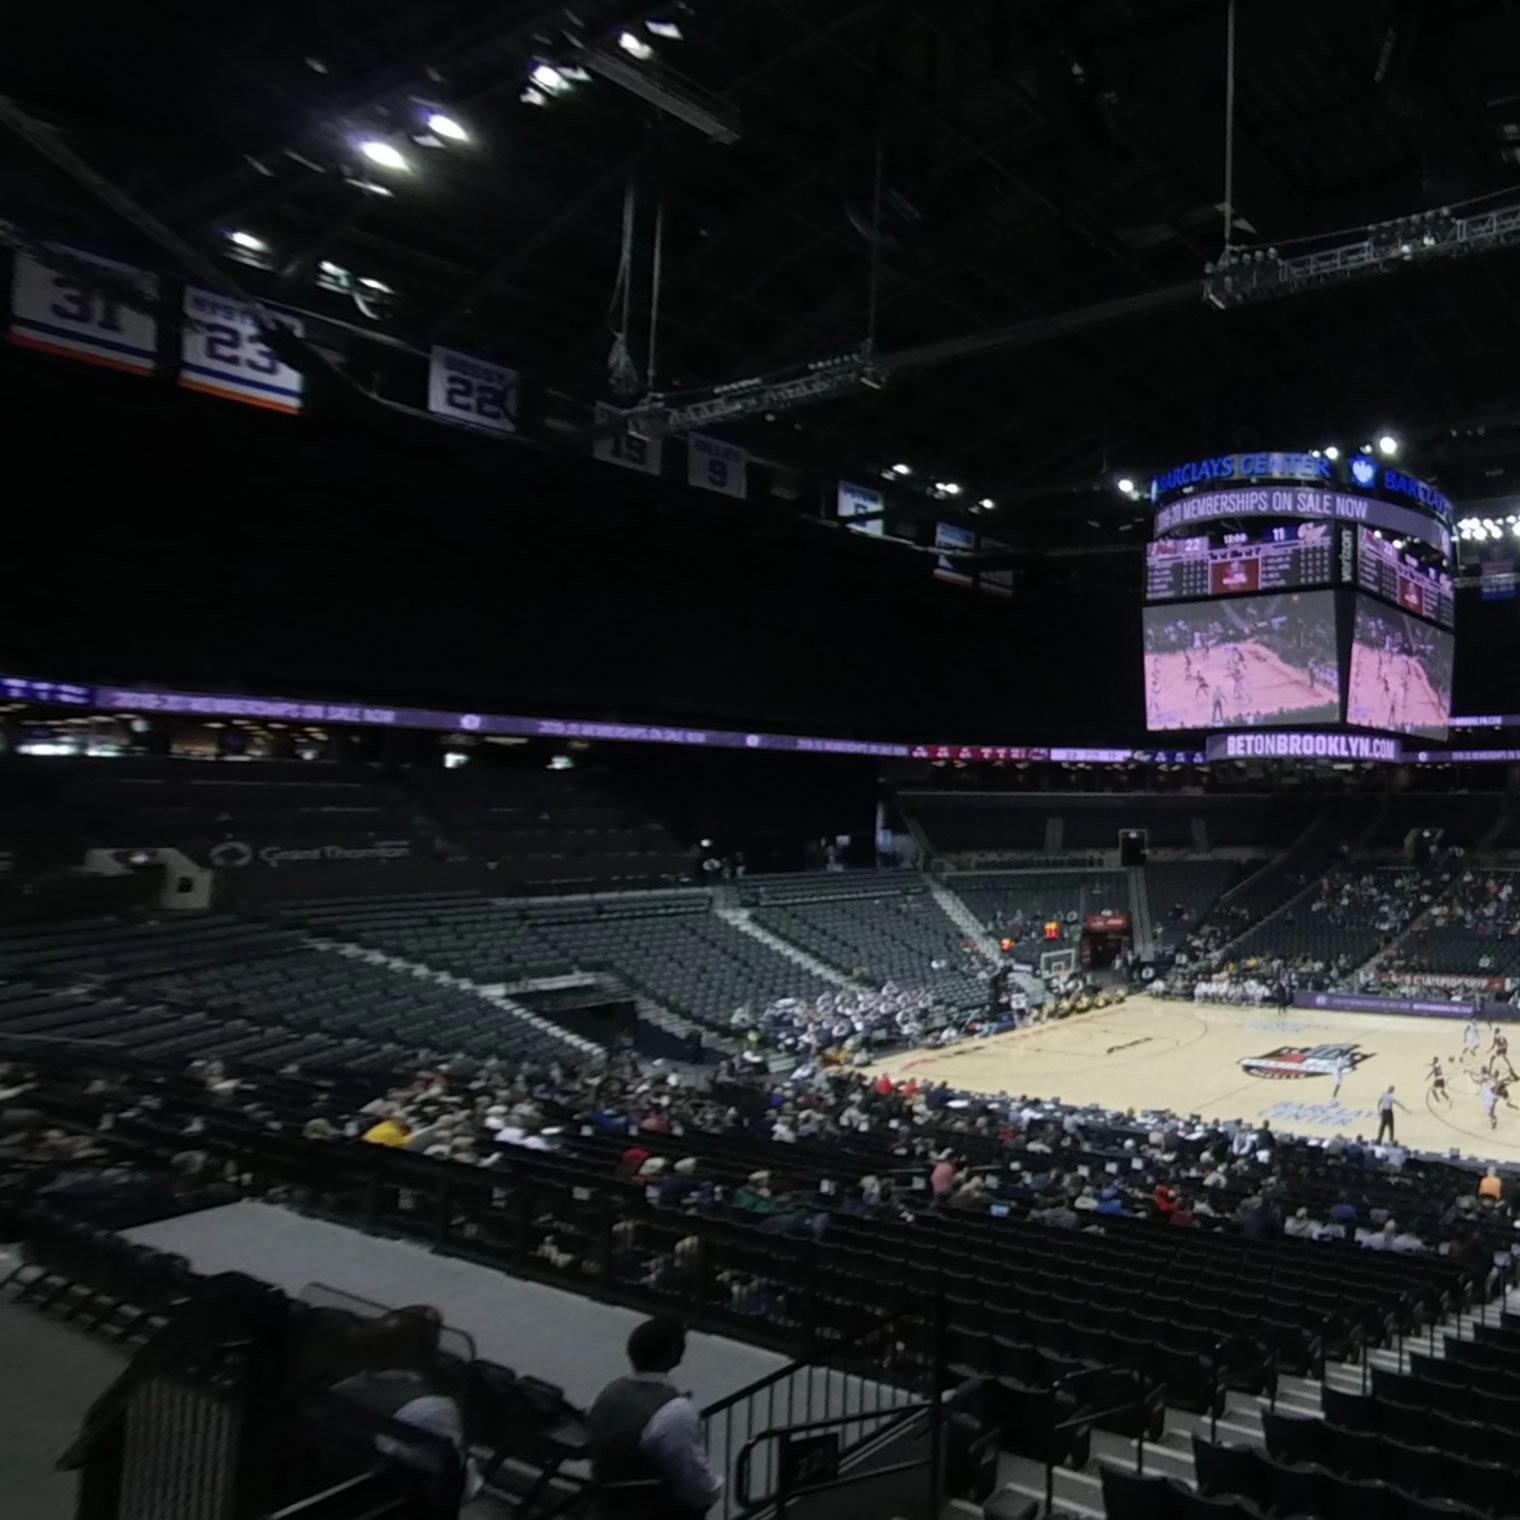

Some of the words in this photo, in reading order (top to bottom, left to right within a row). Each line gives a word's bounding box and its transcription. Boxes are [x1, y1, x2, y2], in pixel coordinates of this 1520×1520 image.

[205, 322, 279, 376] 23
[446, 374, 502, 420] 22
[708, 458, 728, 487] 9
[1240, 452, 1331, 479] CENTER
[1183, 492, 1268, 520] MEMBERSHIPS
[1272, 491, 1293, 512] ON
[1297, 492, 1332, 515] SALE
[1336, 496, 1369, 520] NOW
[1184, 538, 1201, 552] 22
[1272, 527, 1286, 541] 11
[1338, 529, 1353, 582] verizon
[1226, 734, 1395, 759] BETONBROOKLYN.COM
